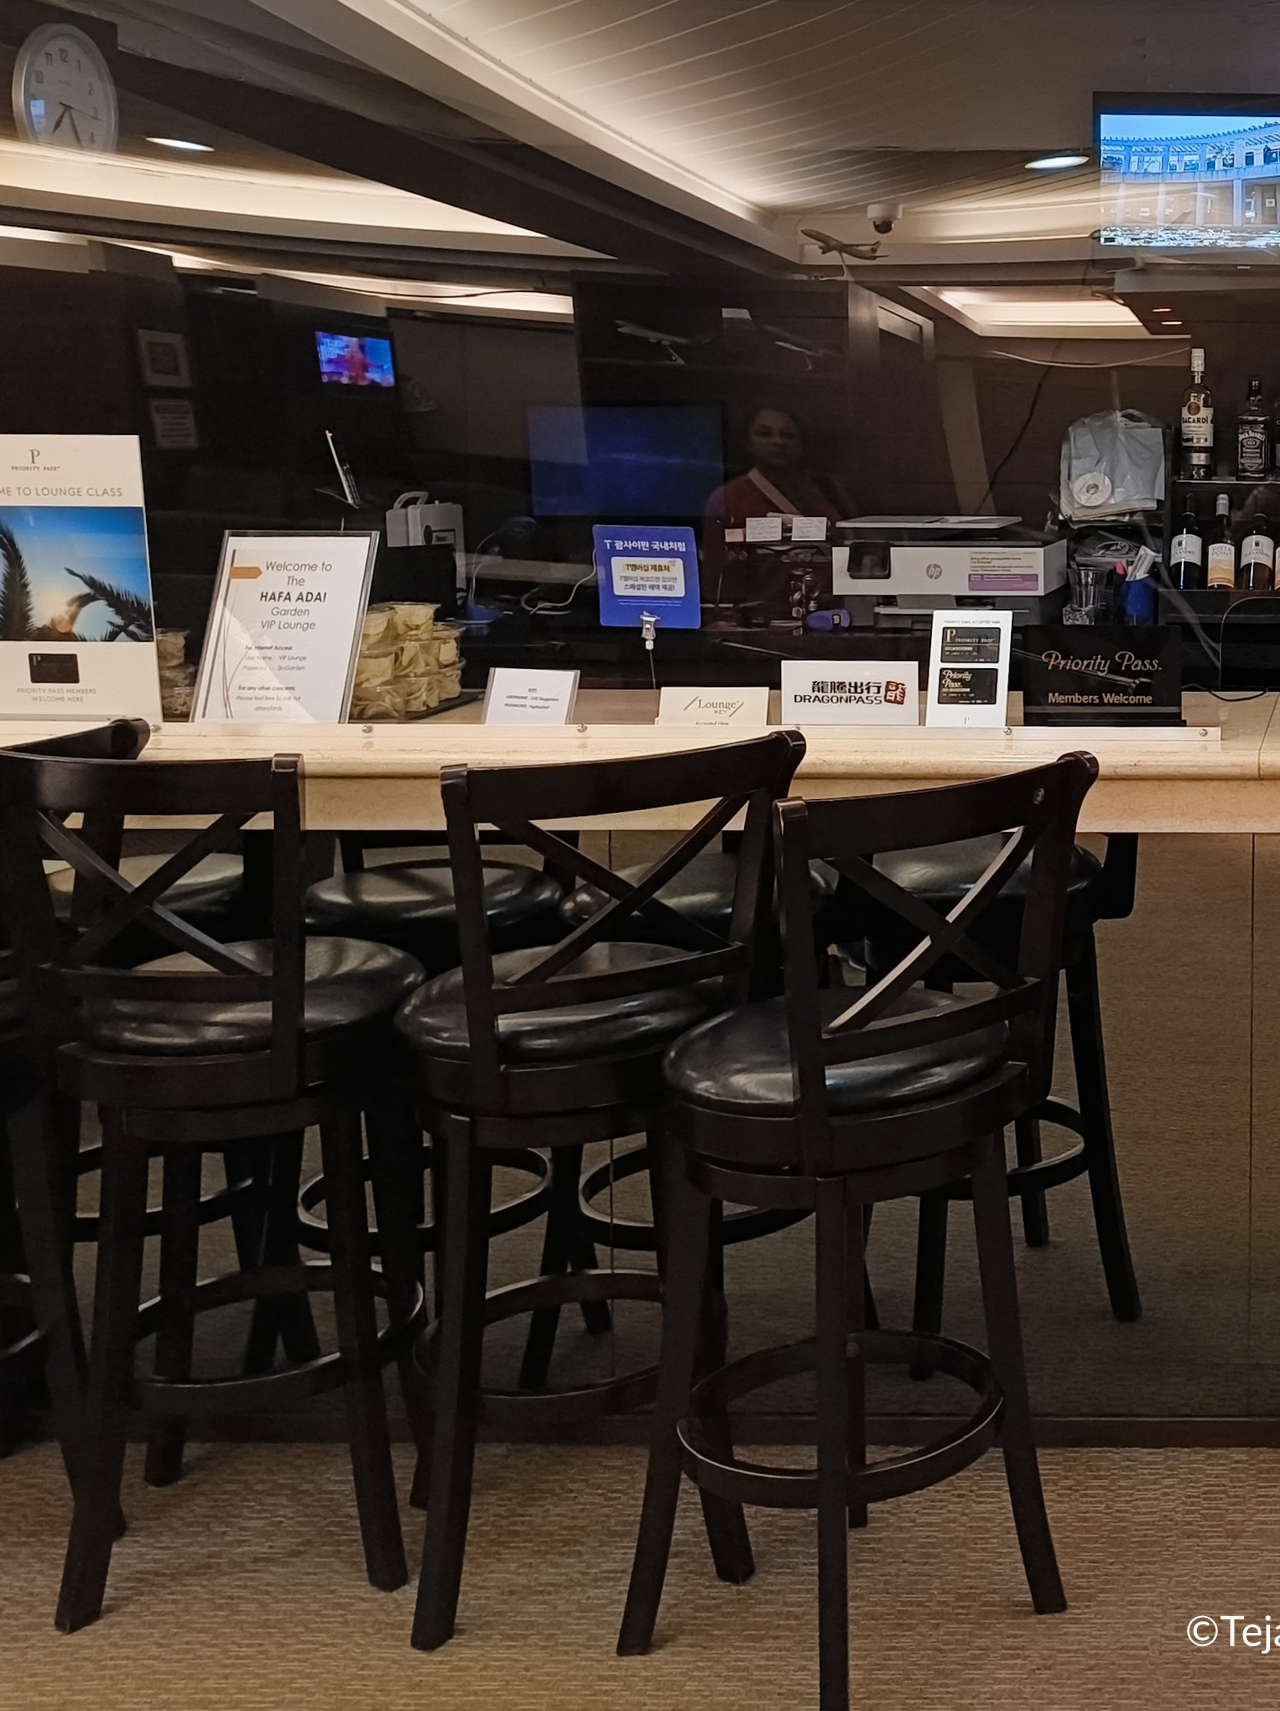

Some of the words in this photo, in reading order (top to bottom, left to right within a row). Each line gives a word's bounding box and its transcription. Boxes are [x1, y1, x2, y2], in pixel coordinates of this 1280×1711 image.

[17, 487, 32, 496] TO
[36, 487, 82, 497] LOUNGE
[86, 488, 123, 497] CLASS
[603, 539, 612, 550] T
[651, 541, 687, 552] 국내처럼
[265, 560, 318, 572] Welcome
[320, 561, 332, 572] to
[927, 563, 943, 579] hp
[287, 576, 305, 586] The
[260, 591, 293, 603] HAFA
[271, 606, 310, 616] Garden
[261, 620, 276, 630] VIP
[278, 620, 316, 631] Lounge
[945, 628, 957, 643] P
[1041, 650, 1110, 676] Priority
[942, 670, 973, 681] Priority
[794, 694, 883, 704] DRAGONPASS
[1048, 692, 1099, 704] Members
[1101, 692, 1153, 704] Welcome
[698, 698, 737, 711] Lounge
